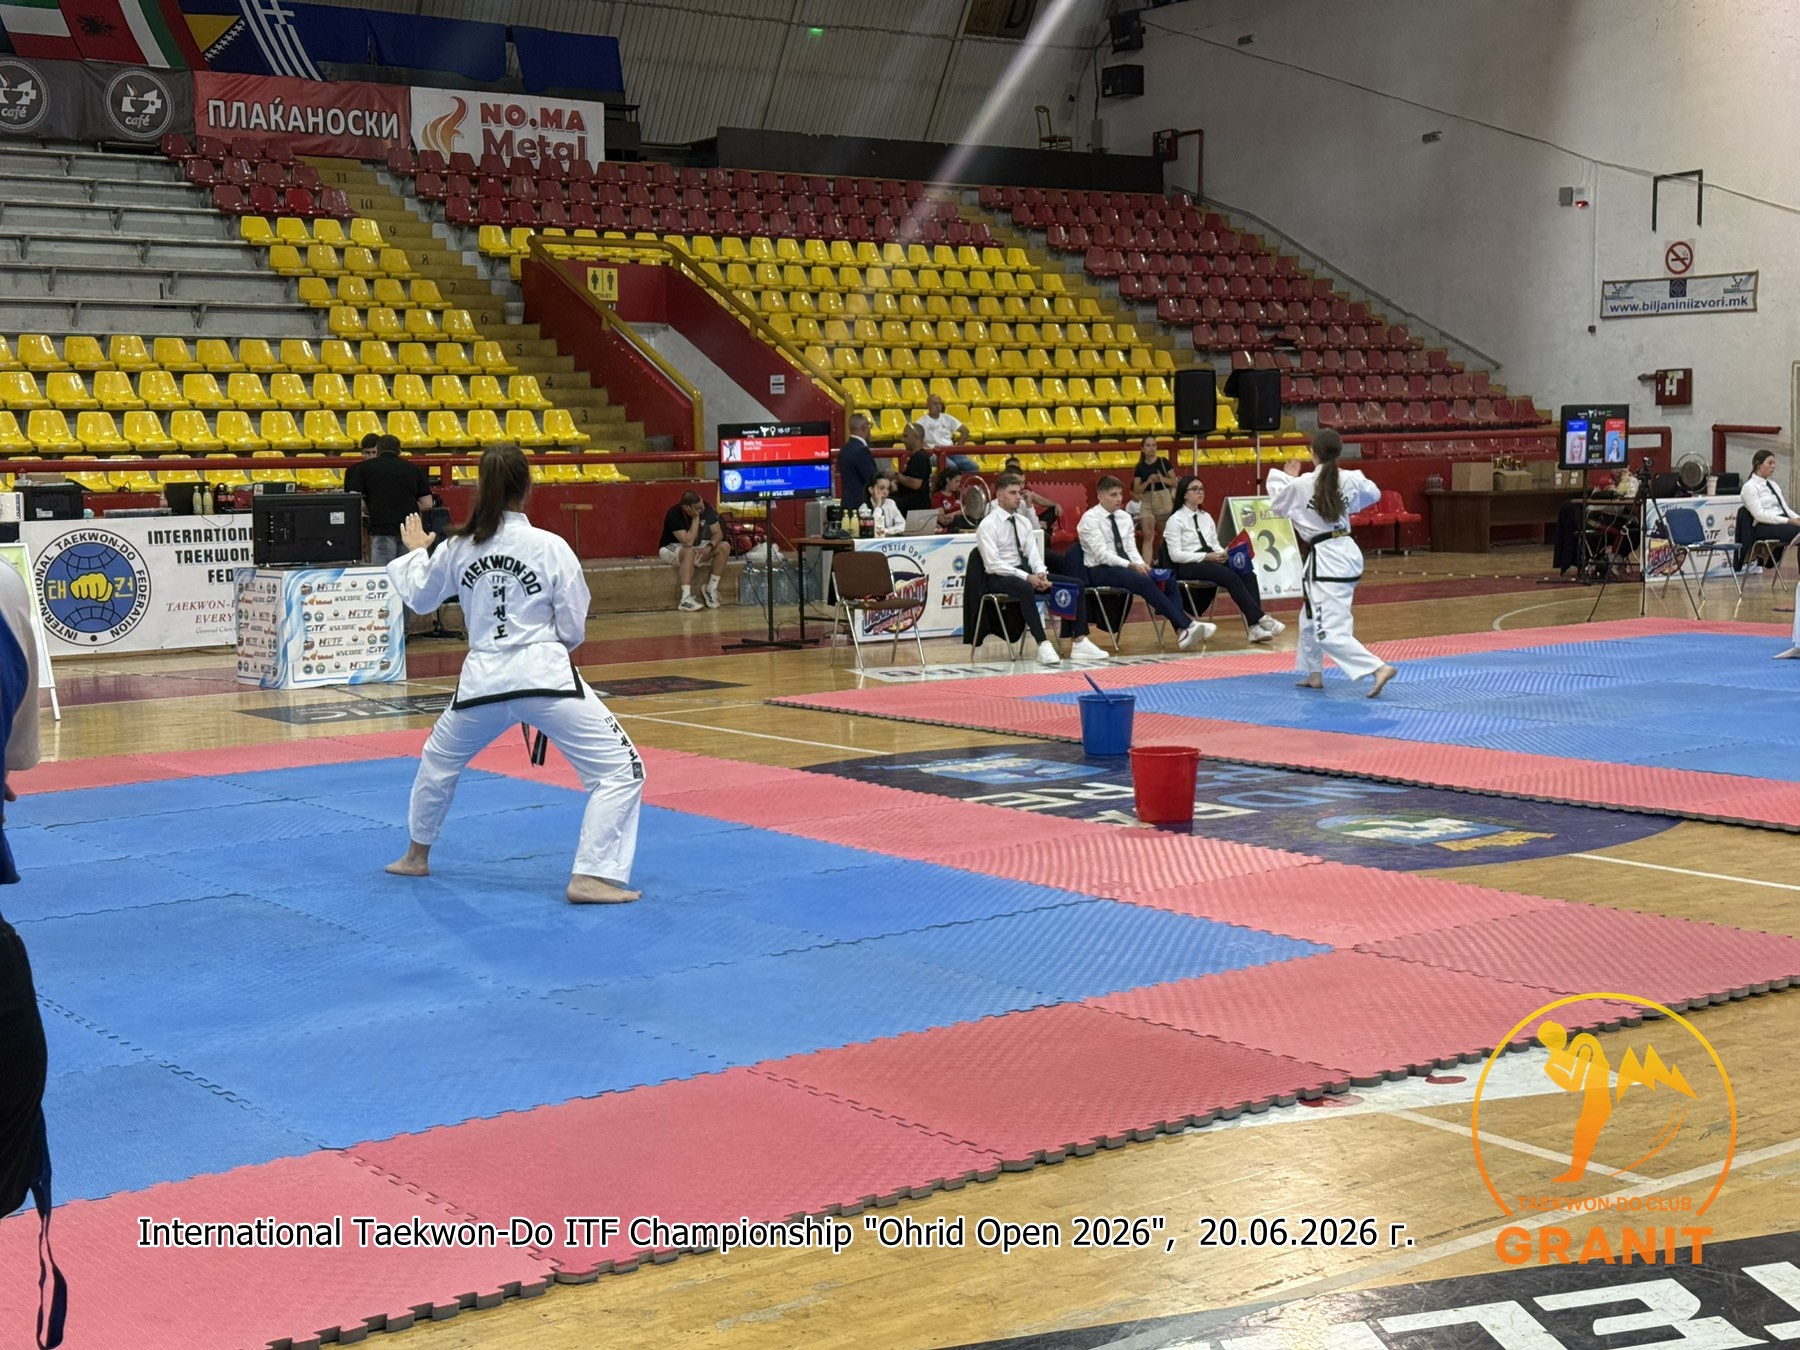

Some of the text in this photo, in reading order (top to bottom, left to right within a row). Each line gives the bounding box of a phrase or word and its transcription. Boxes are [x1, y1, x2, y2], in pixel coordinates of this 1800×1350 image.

[1, 105, 27, 121] café
[207, 97, 400, 140] ПЛАЌАНОСКИ
[125, 114, 151, 128] café
[360, 199, 373, 209] 10
[389, 225, 397, 236] 9
[421, 254, 429, 265] 8
[450, 283, 457, 294] 7
[480, 312, 489, 323] 6
[516, 344, 523, 356] 5
[545, 376, 553, 388] 4
[581, 410, 589, 422] 3
[1592, 431, 1599, 442] 4
[1256, 529, 1282, 573] 3
[461, 555, 542, 596] TAEKWON-DO
[55, 532, 136, 562] TAEKWON-DO
[109, 569, 148, 638] FEDERATION
